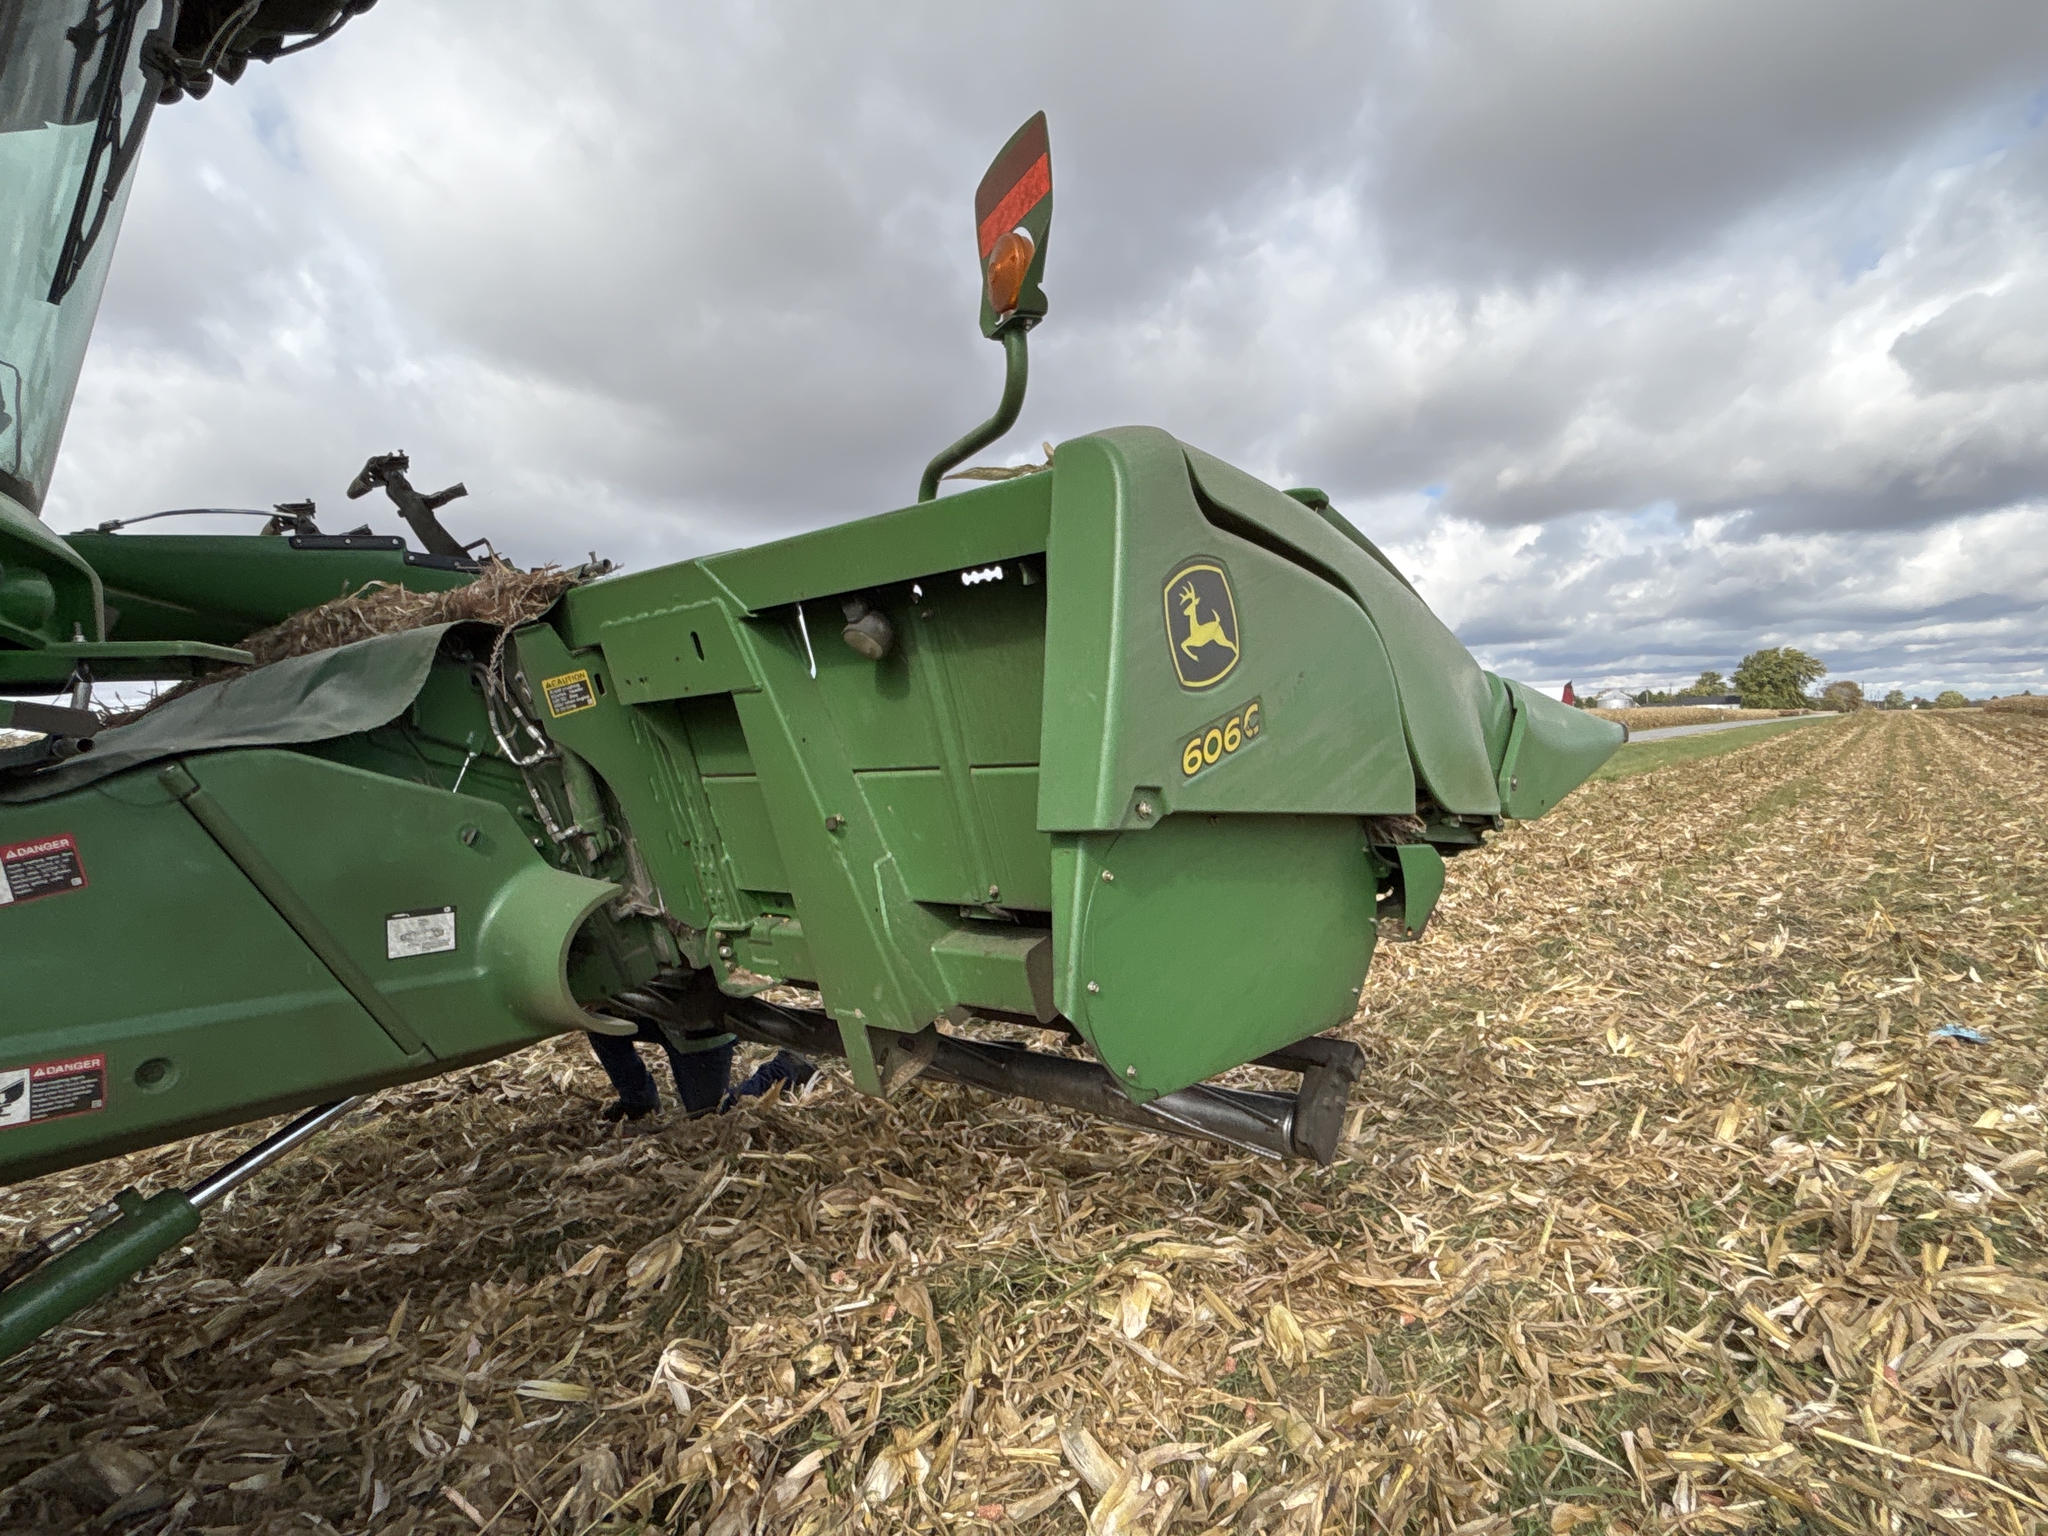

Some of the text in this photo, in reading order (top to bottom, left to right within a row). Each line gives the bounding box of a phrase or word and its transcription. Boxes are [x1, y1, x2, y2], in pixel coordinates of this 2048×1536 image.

[551, 672, 586, 687] CAUTION
[1182, 702, 1260, 776] 606C
[17, 838, 70, 857] DANGER
[46, 1058, 101, 1075] DANGER
